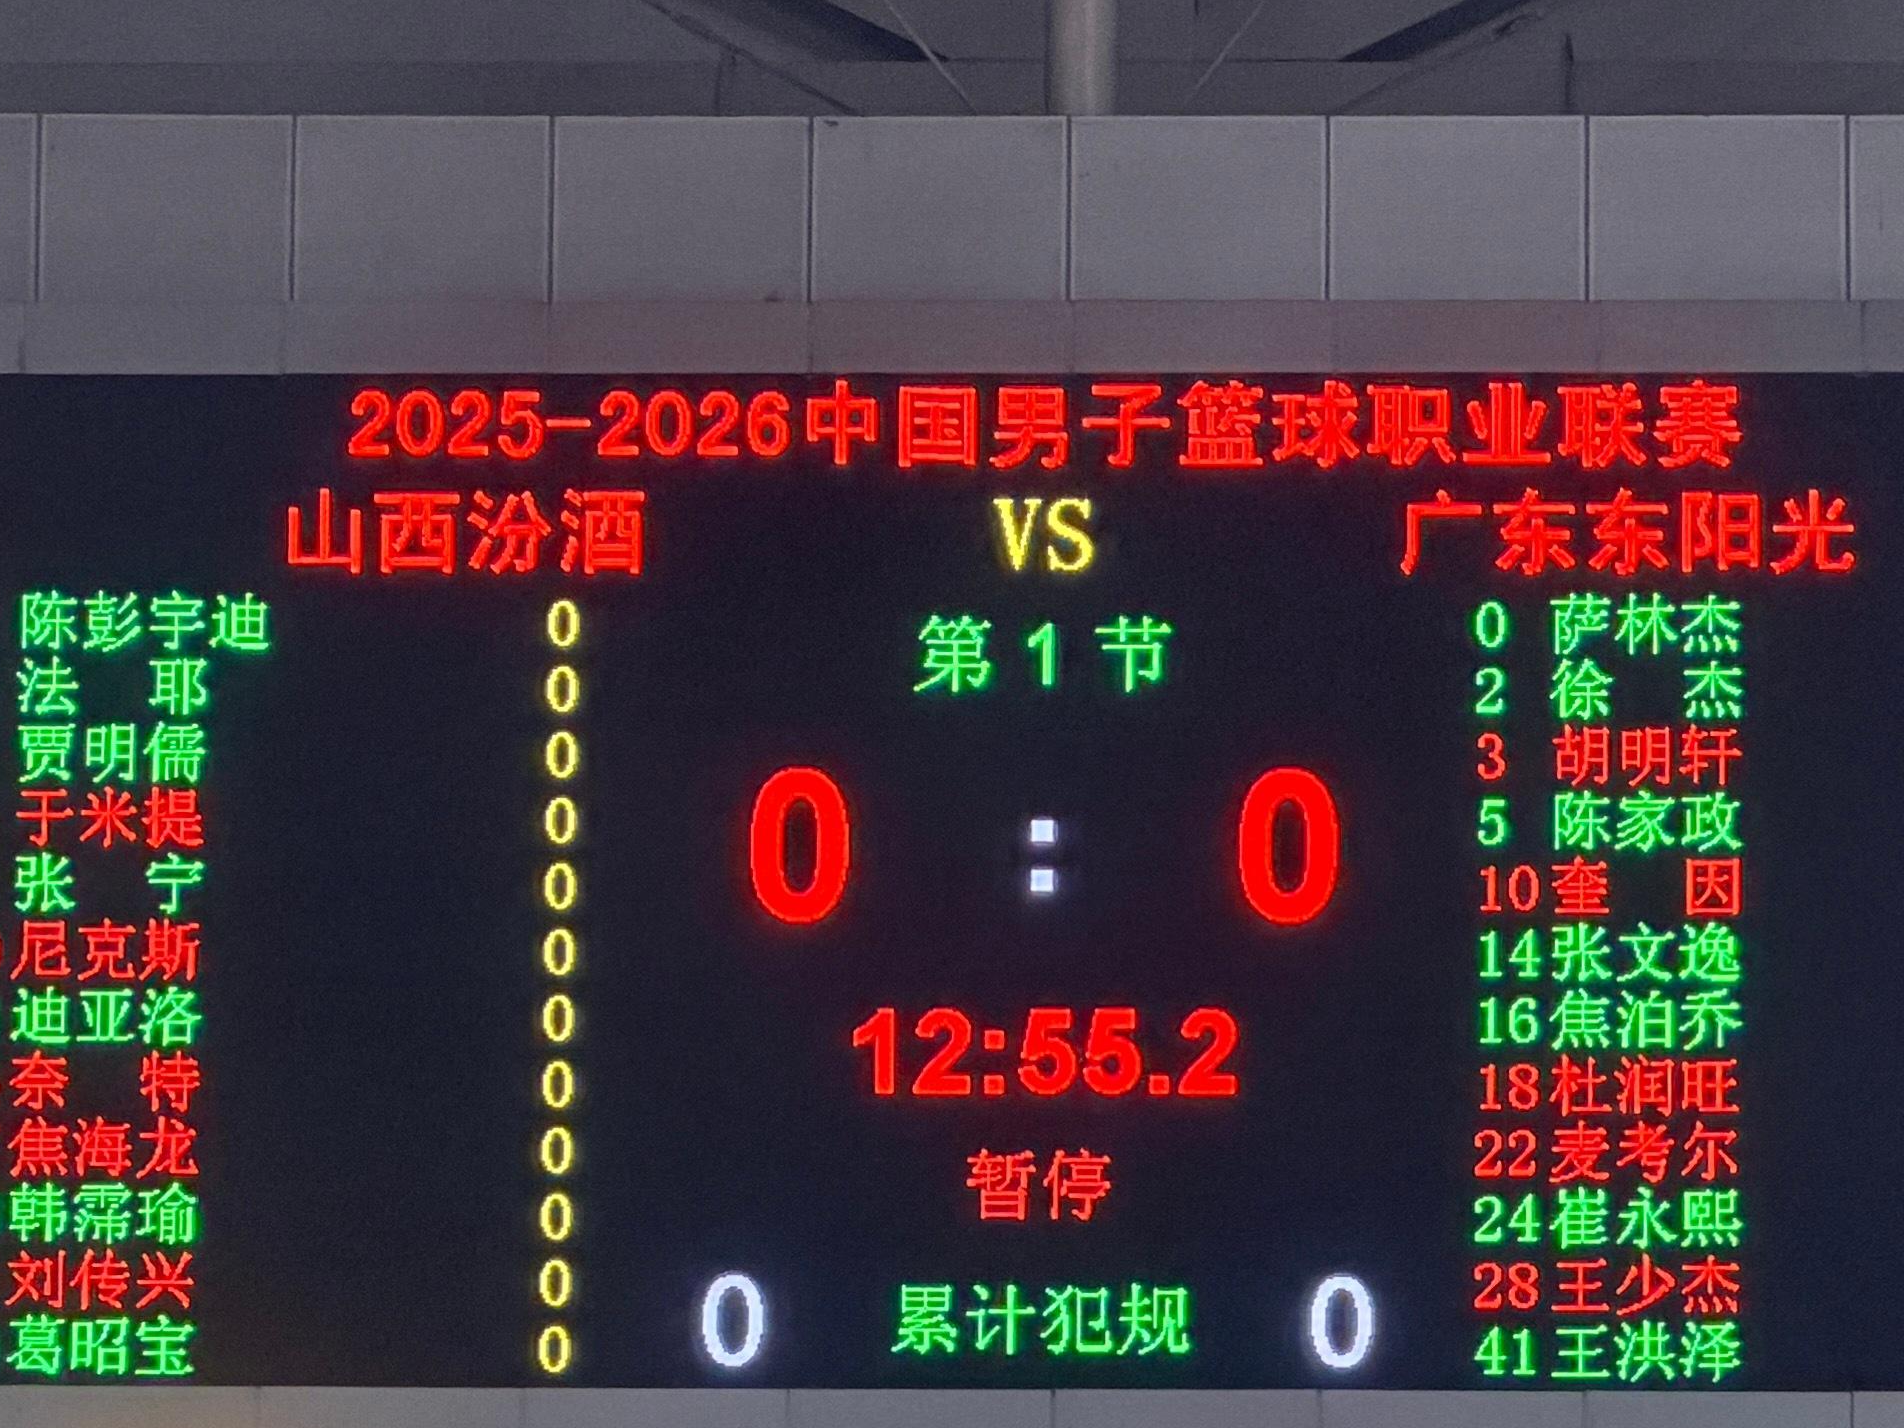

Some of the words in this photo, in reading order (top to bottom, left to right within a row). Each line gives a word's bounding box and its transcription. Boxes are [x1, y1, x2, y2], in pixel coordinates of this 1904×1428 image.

[348, 380, 1742, 469] 2025-2026中国男子篮球职业联赛
[288, 488, 645, 574] 山西汾酒
[993, 498, 1093, 570] VS
[1401, 487, 1854, 576] 广东东阳光
[22, 590, 269, 652] 陈彭宇迪
[548, 601, 580, 647] 0
[1476, 602, 1507, 647] 0
[1550, 593, 1740, 655] 萨林杰
[547, 666, 579, 712] 0
[1476, 668, 1504, 714] 2
[18, 721, 205, 783] 贾明儒
[546, 732, 578, 778] 0
[1478, 733, 1505, 779] 3
[1553, 724, 1742, 786] 胡明轩
[16, 787, 203, 848] 于米提
[546, 797, 577, 844] 0
[750, 768, 849, 924] 0
[1239, 768, 1339, 924] 0
[1478, 799, 1506, 845] 5
[1555, 790, 1742, 852] 陈家政
[545, 863, 577, 910] 0
[1481, 865, 1539, 911] 10
[11, 919, 199, 980] 尼克斯
[544, 929, 575, 975] 0
[1480, 929, 1541, 977] 14
[1552, 922, 1740, 982] 张文逸
[10, 986, 202, 1046] 迪亚洛
[543, 995, 575, 1041] 0
[1480, 997, 1538, 1043] 16
[1549, 988, 1742, 1050] 焦泊乔
[853, 1008, 1238, 1097] 12:55.2
[543, 1061, 573, 1108] 0
[1480, 1064, 1538, 1110] 18
[1550, 1054, 1739, 1116] 杜润旺
[8, 1116, 198, 1178] 焦海龙
[541, 1127, 573, 1174] 0
[1475, 1130, 1536, 1177] 22
[1549, 1120, 1737, 1183] 麦考尔
[9, 1182, 196, 1244] 韩霈瑜
[967, 1148, 1110, 1220] 暂停
[541, 1193, 573, 1240] 0
[1475, 1194, 1540, 1242] 24
[1549, 1187, 1742, 1249] 崔永熙
[5, 1249, 194, 1310] 刘传兴
[540, 1260, 571, 1306] 0
[1475, 1263, 1538, 1309] 28
[1552, 1254, 1739, 1315] 王少杰
[7, 1314, 194, 1374] 葛昭宝
[539, 1326, 571, 1372] 0
[702, 1274, 766, 1367] 0
[892, 1283, 1189, 1355] 累计犯规
[1310, 1276, 1375, 1368] 0
[1475, 1327, 1535, 1375] 41
[1551, 1320, 1740, 1382] 王洪泽
